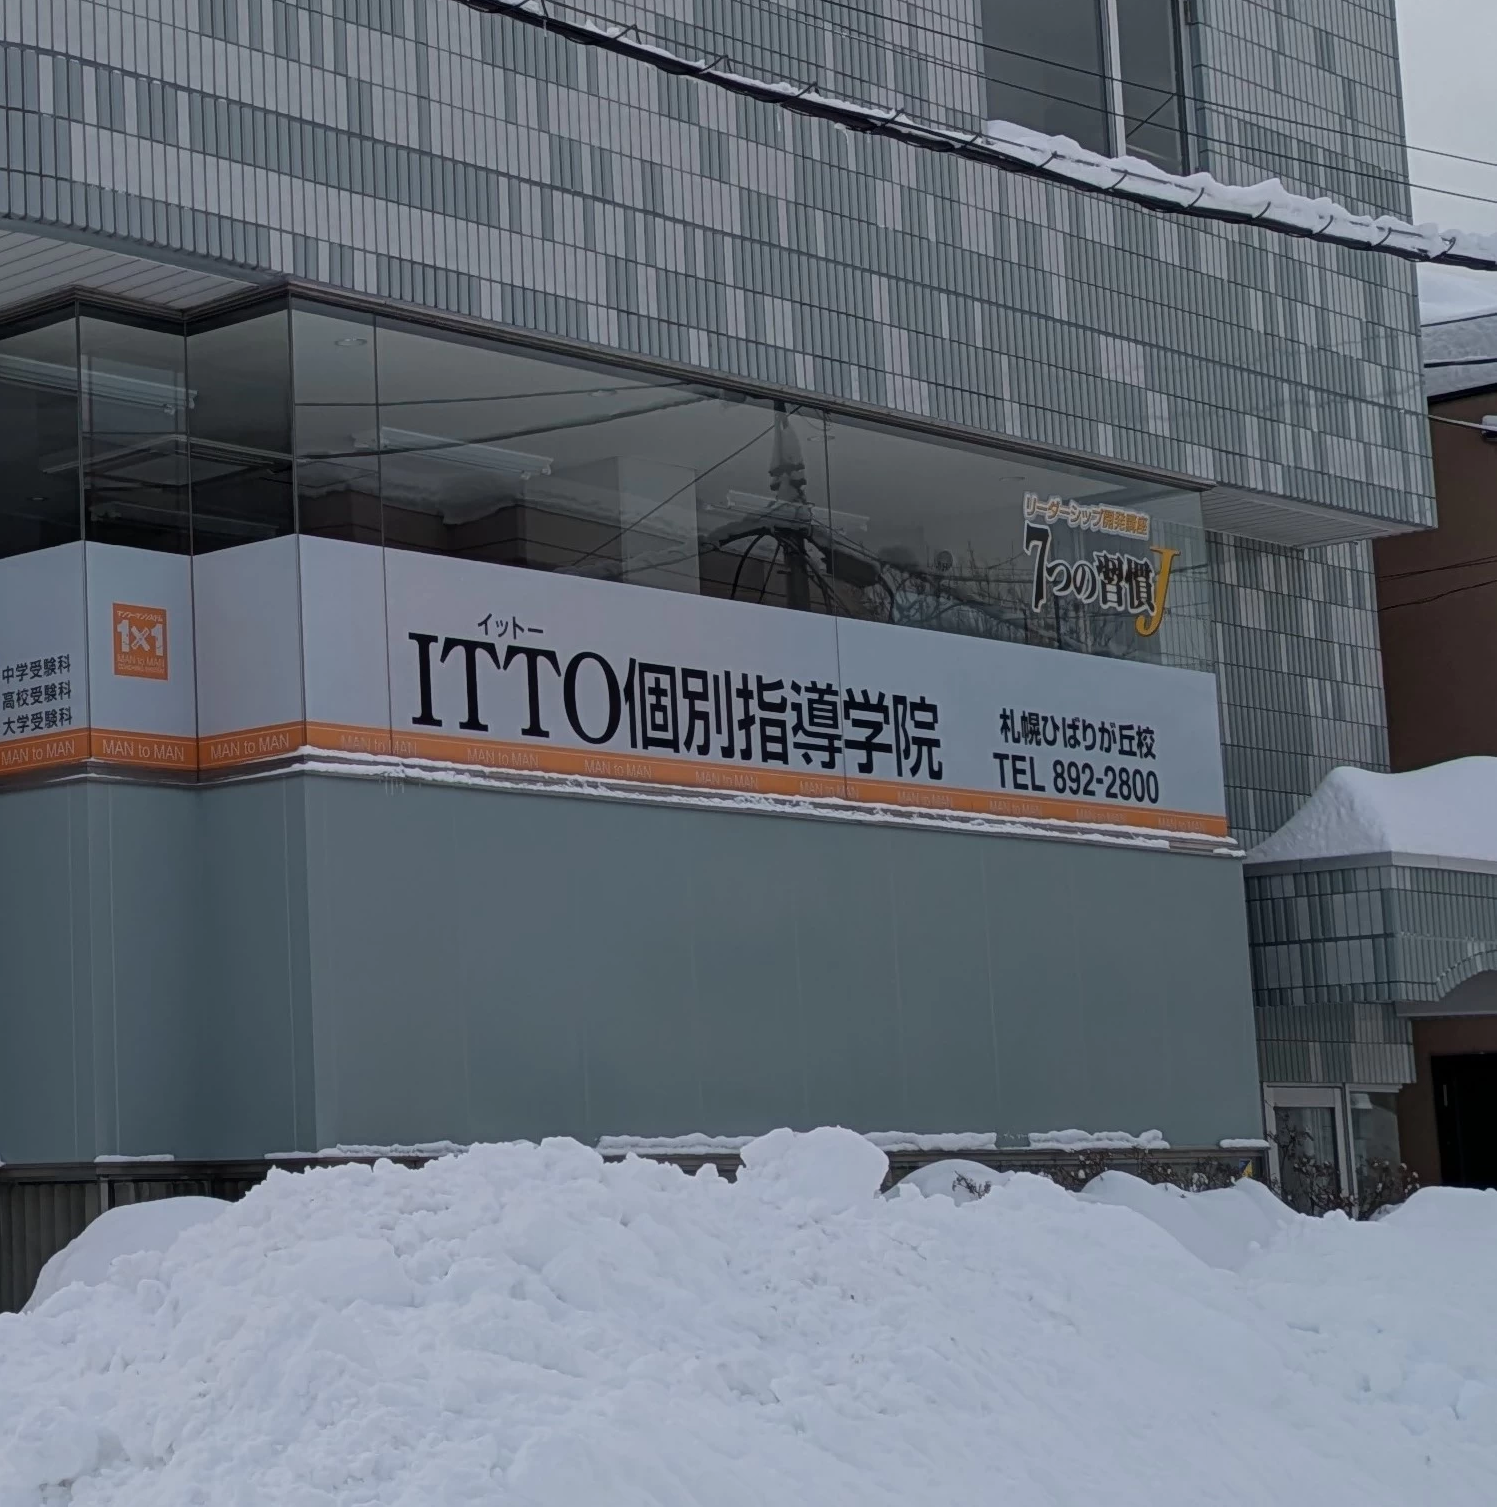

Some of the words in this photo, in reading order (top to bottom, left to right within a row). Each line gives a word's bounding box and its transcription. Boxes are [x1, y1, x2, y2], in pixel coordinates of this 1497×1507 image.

[477, 612, 544, 641] イットー
[2, 654, 71, 684] 中学受験科
[2, 680, 72, 711] 高校受験科
[408, 631, 943, 780] ITTO個別指導学院
[3, 706, 73, 736] 大学受験科
[999, 707, 1156, 760] 札幌ひばりが丘校
[1, 749, 29, 765] MAN
[32, 746, 43, 760] to
[46, 739, 75, 757] MAN
[103, 740, 134, 756] MAN
[139, 743, 150, 758] to
[154, 744, 184, 761] MAN
[210, 741, 241, 759] MAN
[259, 733, 289, 751] MAN
[467, 748, 495, 763] MAN
[511, 753, 539, 768] MAN
[584, 759, 611, 775] MAN
[626, 763, 652, 780] MAN
[993, 752, 1046, 792] TEL
[1053, 759, 1159, 804] 892-2800
